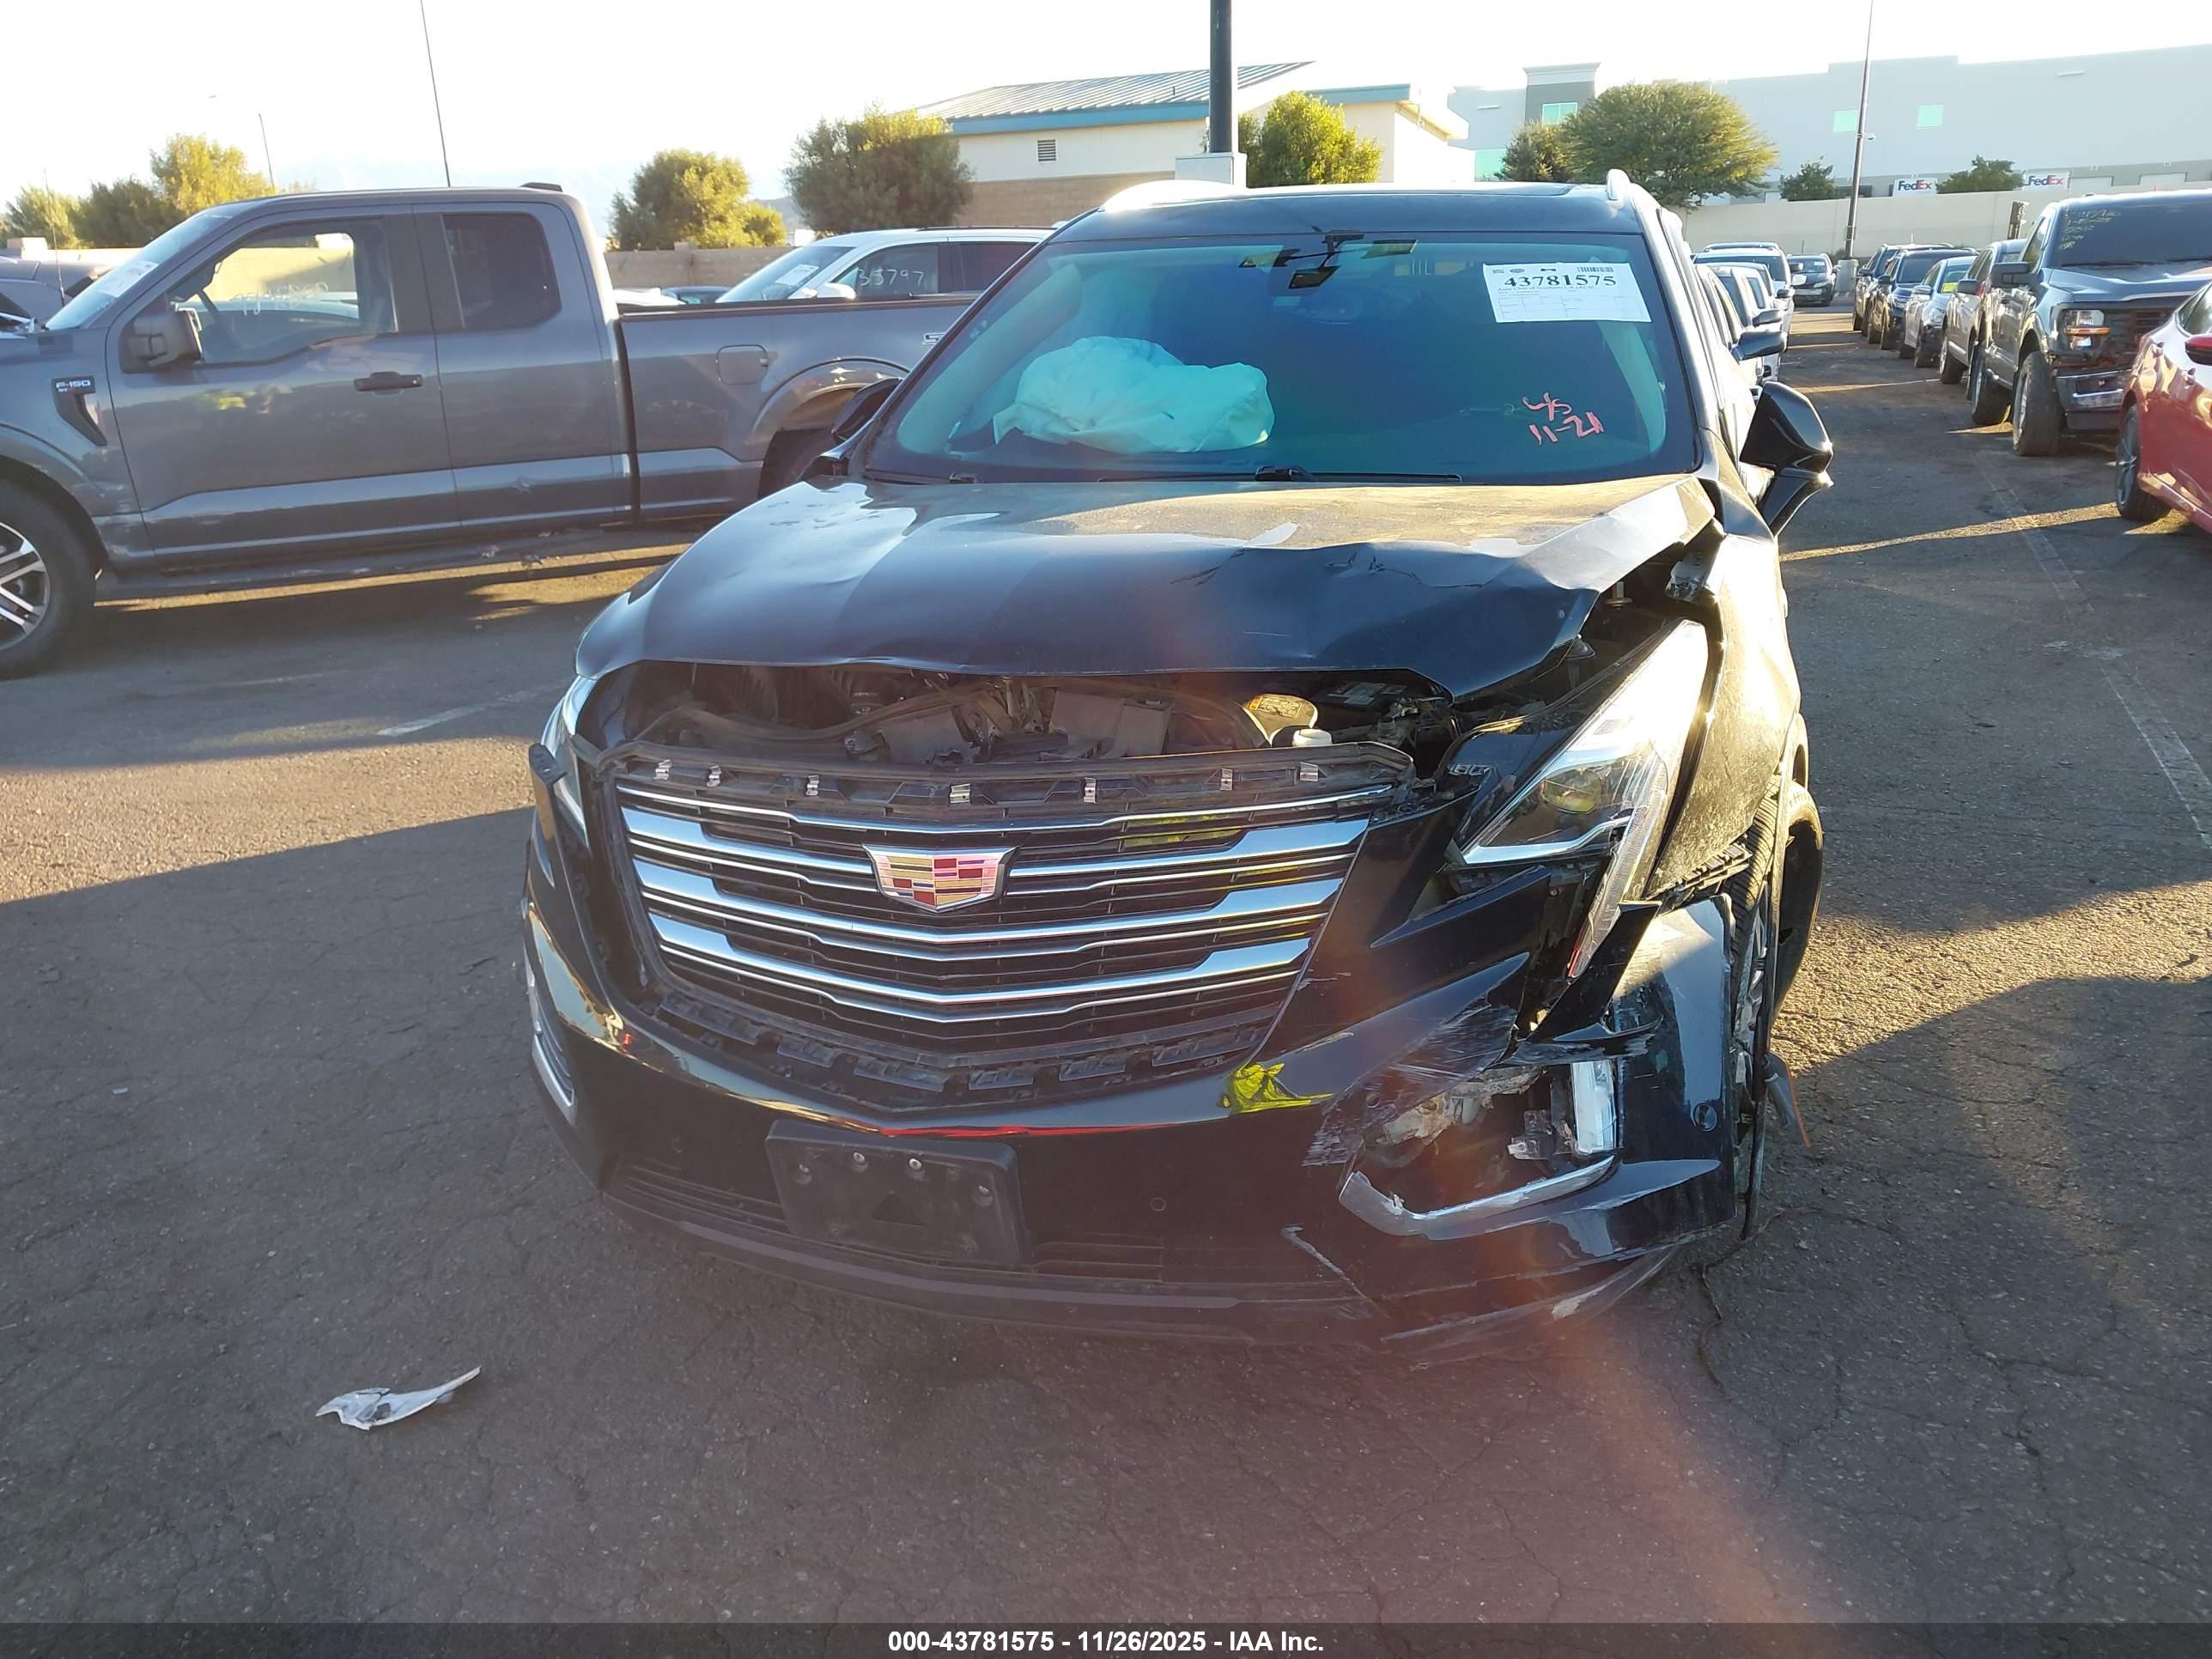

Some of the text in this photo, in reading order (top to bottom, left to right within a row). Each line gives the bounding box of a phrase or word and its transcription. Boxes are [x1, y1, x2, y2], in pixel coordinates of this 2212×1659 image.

[1898, 179, 1932, 191] FedEx
[2027, 174, 2064, 185] FedEx
[1504, 274, 1616, 287] 43781575
[56, 380, 91, 389] F-150
